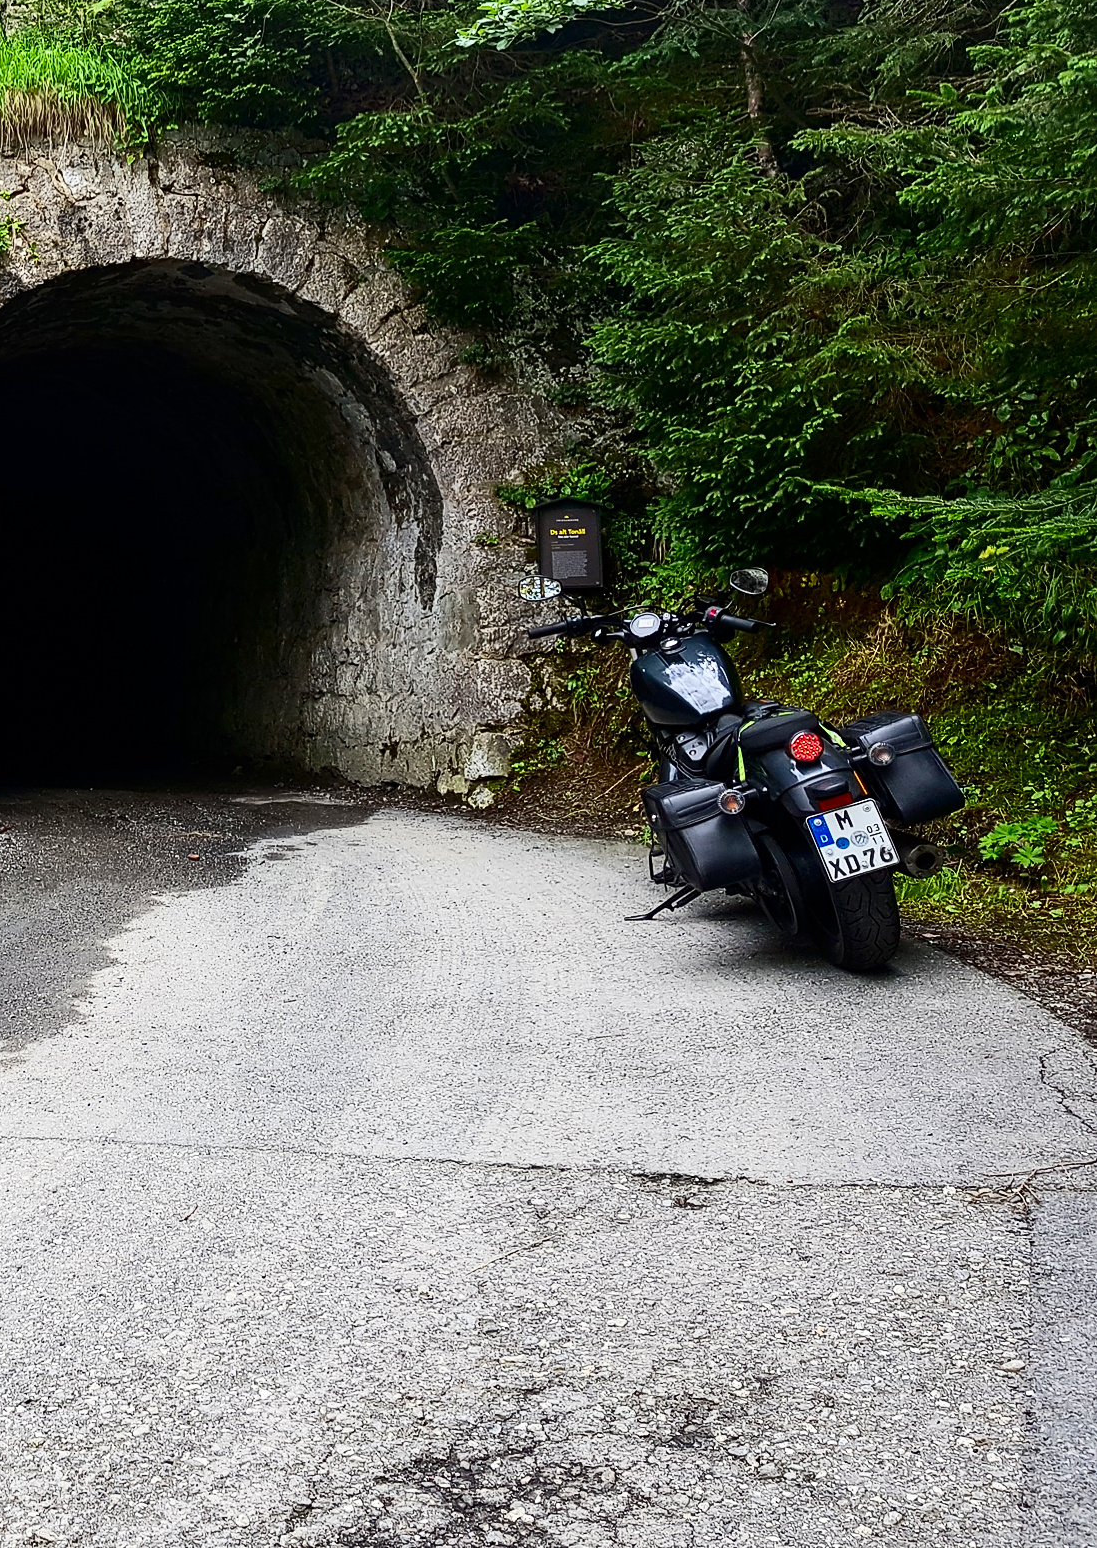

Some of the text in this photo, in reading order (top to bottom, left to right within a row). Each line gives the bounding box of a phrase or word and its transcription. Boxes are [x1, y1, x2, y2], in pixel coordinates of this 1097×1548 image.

[834, 810, 853, 830] M
[866, 823, 880, 833] 03
[820, 834, 828, 843] D
[872, 835, 884, 845] 11
